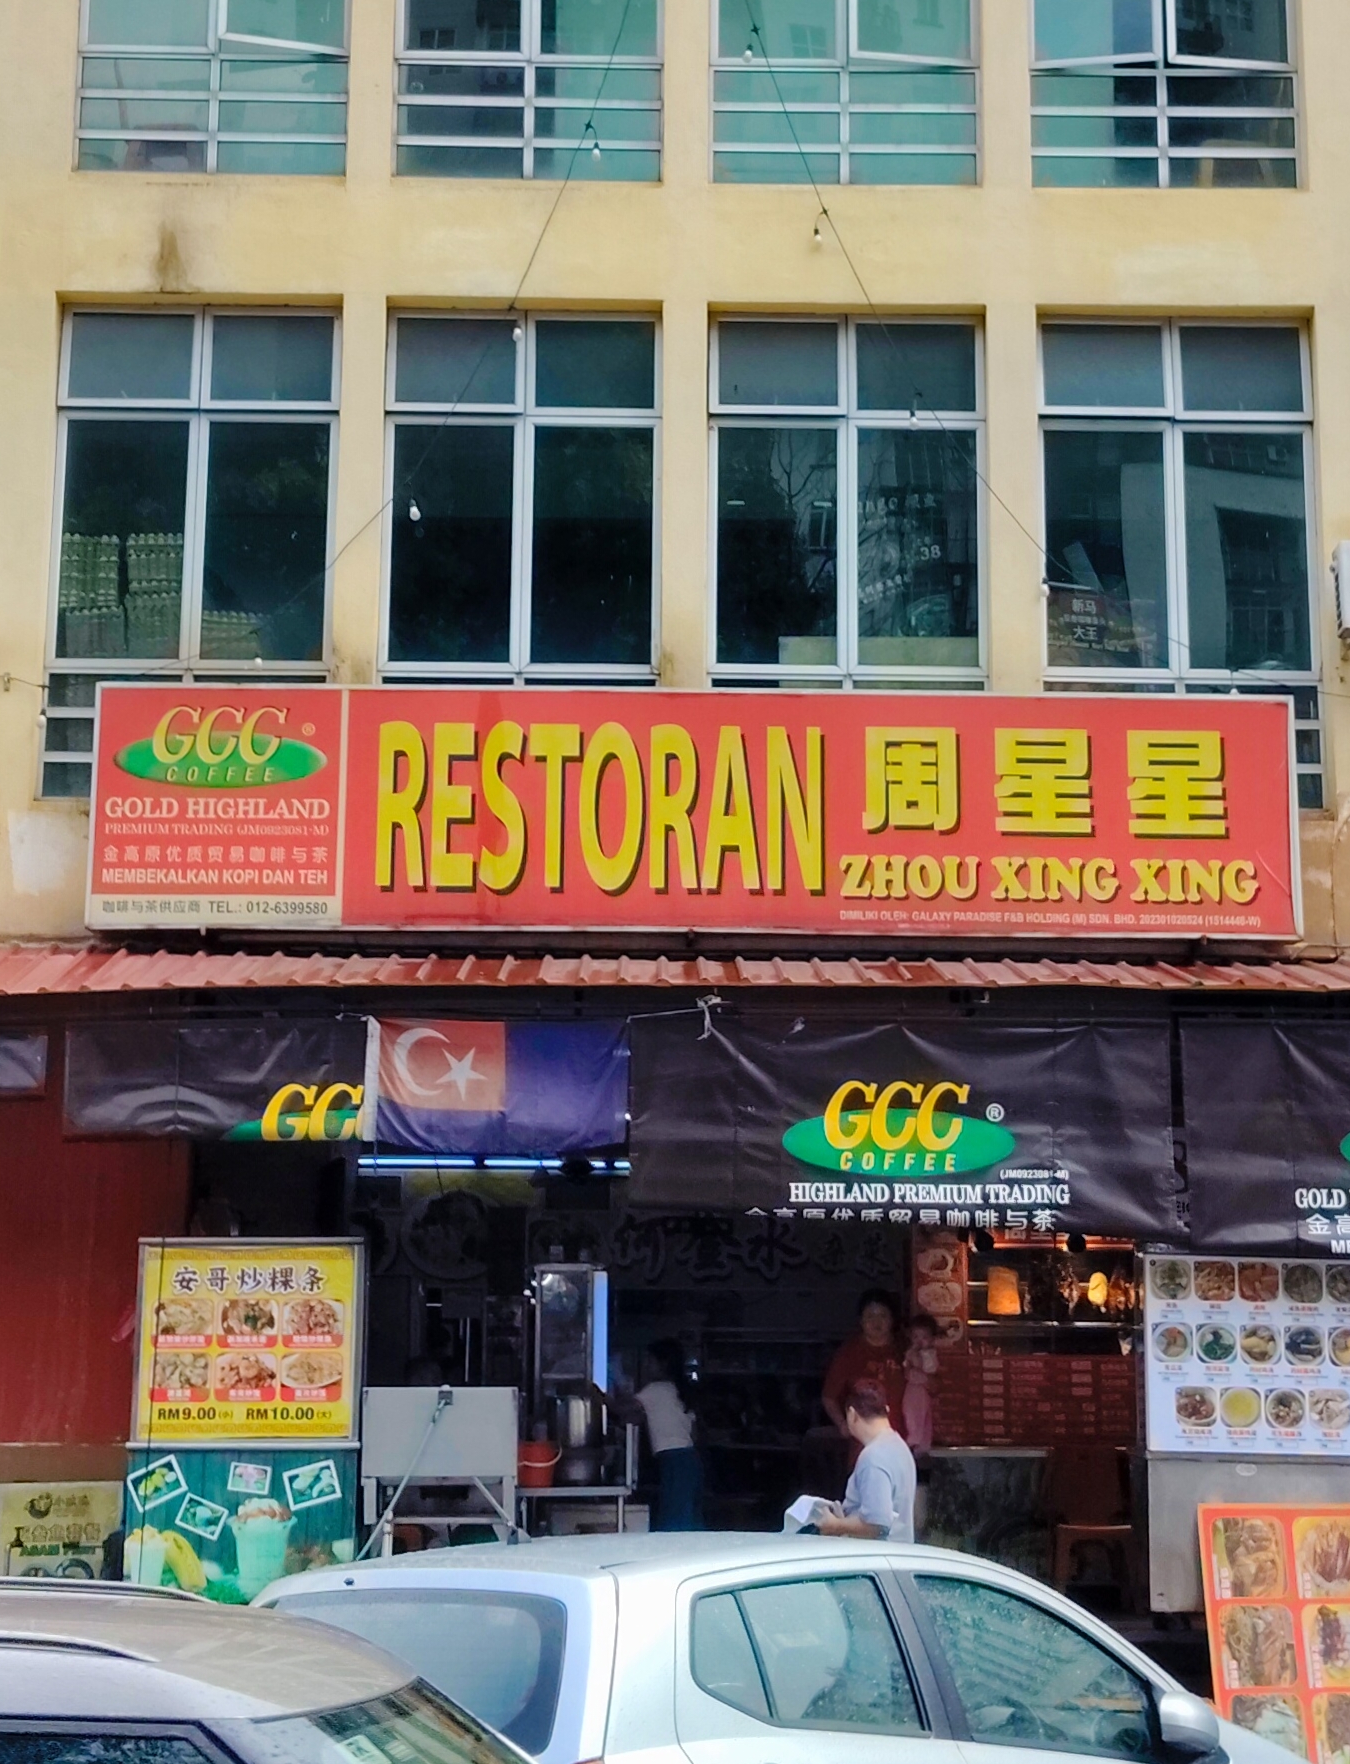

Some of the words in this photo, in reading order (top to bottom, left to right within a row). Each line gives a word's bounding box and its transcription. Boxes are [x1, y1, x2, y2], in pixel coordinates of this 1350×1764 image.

[151, 705, 289, 766] GCC
[166, 766, 276, 783] COFFEE
[862, 726, 1226, 837] 周星星
[105, 797, 179, 819] GOLD
[185, 797, 331, 821] HIGHLAND
[375, 721, 822, 895] RESTORAN
[104, 823, 167, 836] PREMIUM
[169, 823, 234, 837] TRADING
[103, 846, 329, 865] 金高原优质贸易咖啡与茶
[101, 868, 220, 885] MEMBEKALKAN
[222, 869, 259, 885] KOPI
[262, 869, 295, 885] DAN
[298, 869, 328, 885] TEH
[839, 854, 981, 900] ZHOU
[990, 856, 1121, 902] XING
[1129, 858, 1260, 904] XING
[101, 899, 201, 915] 咖啡与茶供应商
[246, 901, 328, 916] 012-6399580
[911, 912, 952, 923] GALAXY
[953, 912, 1002, 923] PARADISE
[1004, 913, 1024, 924] F&B
[1025, 913, 1071, 924] HOLDING
[823, 1080, 971, 1151] GCC
[839, 1151, 957, 1172] COFFEE
[789, 1182, 890, 1204] HIGHLAND
[893, 1183, 985, 1204] PREMIUM
[986, 1184, 1070, 1205] TRADING
[1295, 1188, 1347, 1209] GOLD
[172, 1265, 326, 1294] 安哥炒粿条
[157, 1407, 217, 1421] RM9.00
[245, 1406, 315, 1421] RM10.00
